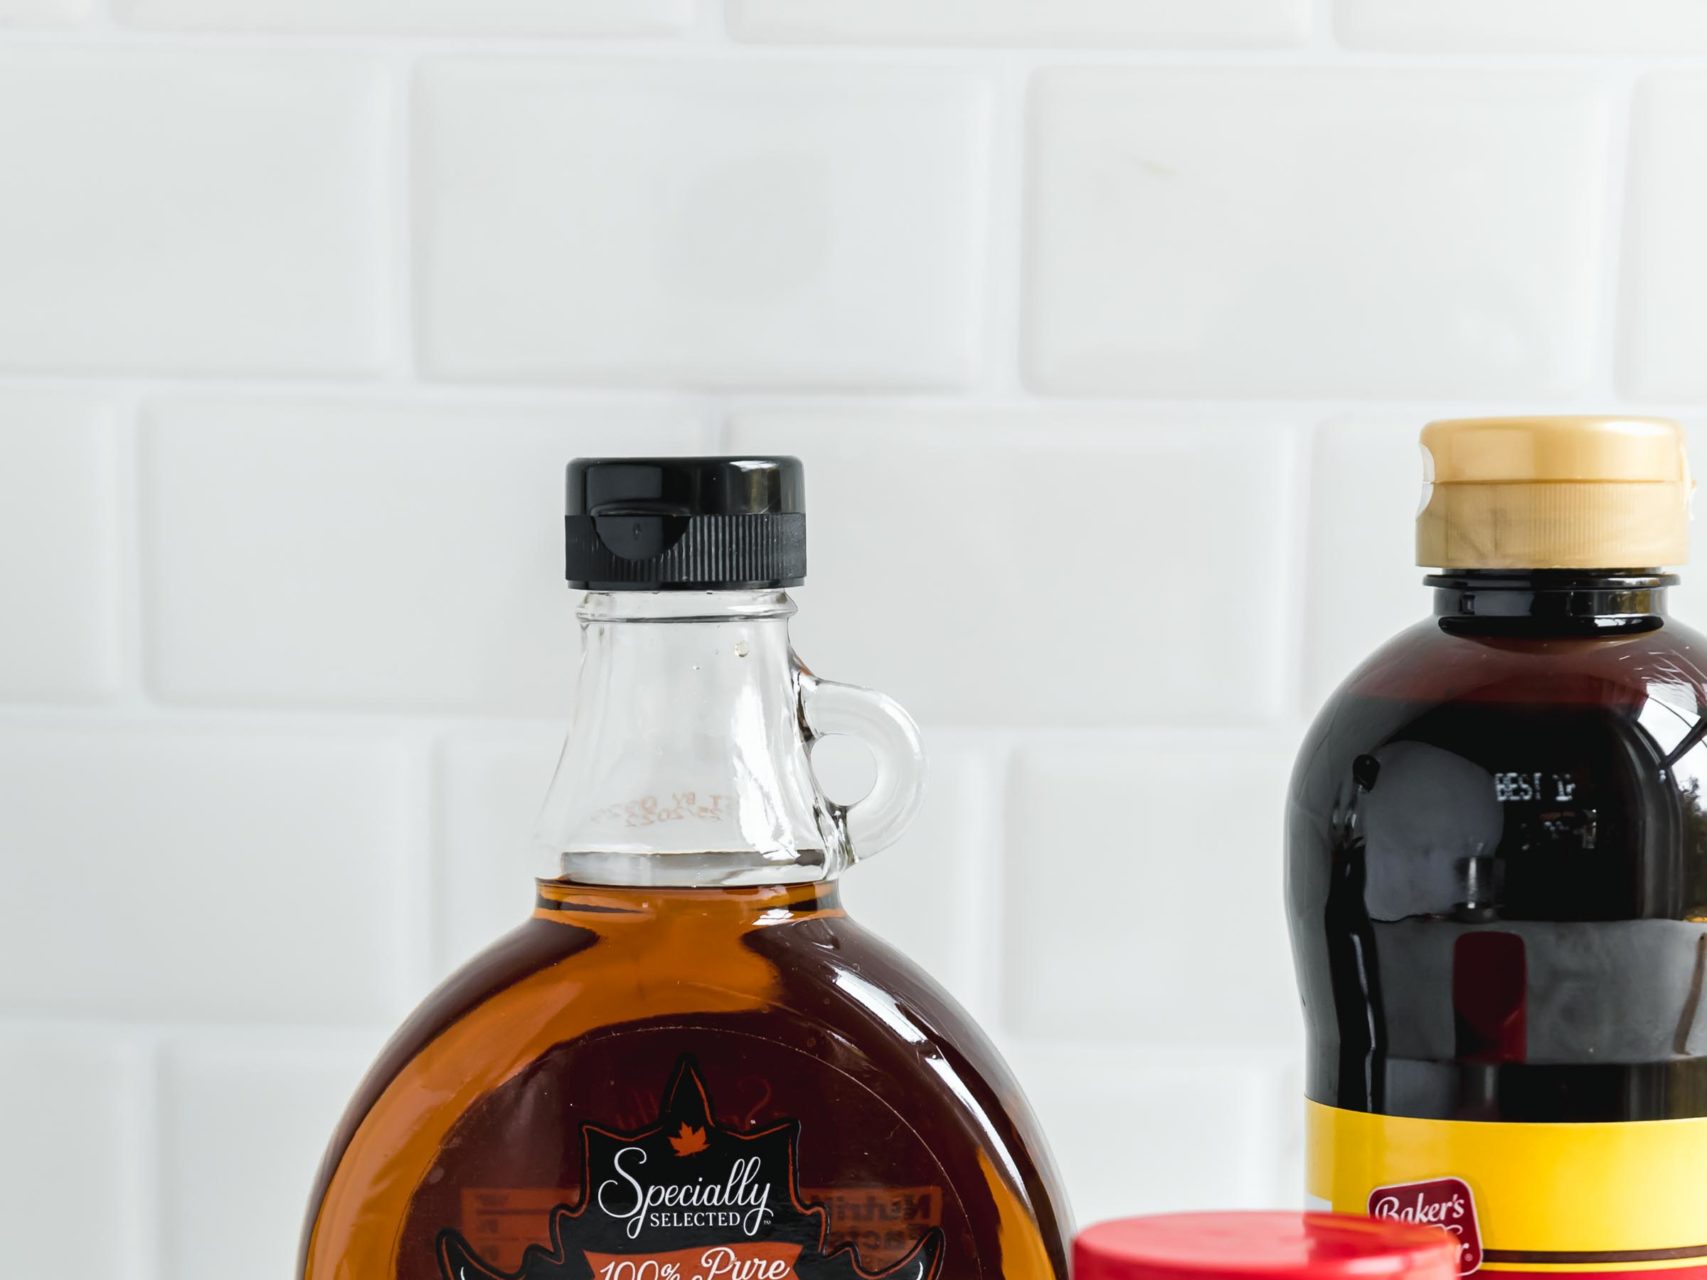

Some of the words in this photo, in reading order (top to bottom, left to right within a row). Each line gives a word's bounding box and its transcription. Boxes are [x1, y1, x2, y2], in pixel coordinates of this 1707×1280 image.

[598, 1147, 774, 1239] Specially
[1375, 1193, 1464, 1224] Baker's
[650, 1212, 741, 1227] SELECTED
